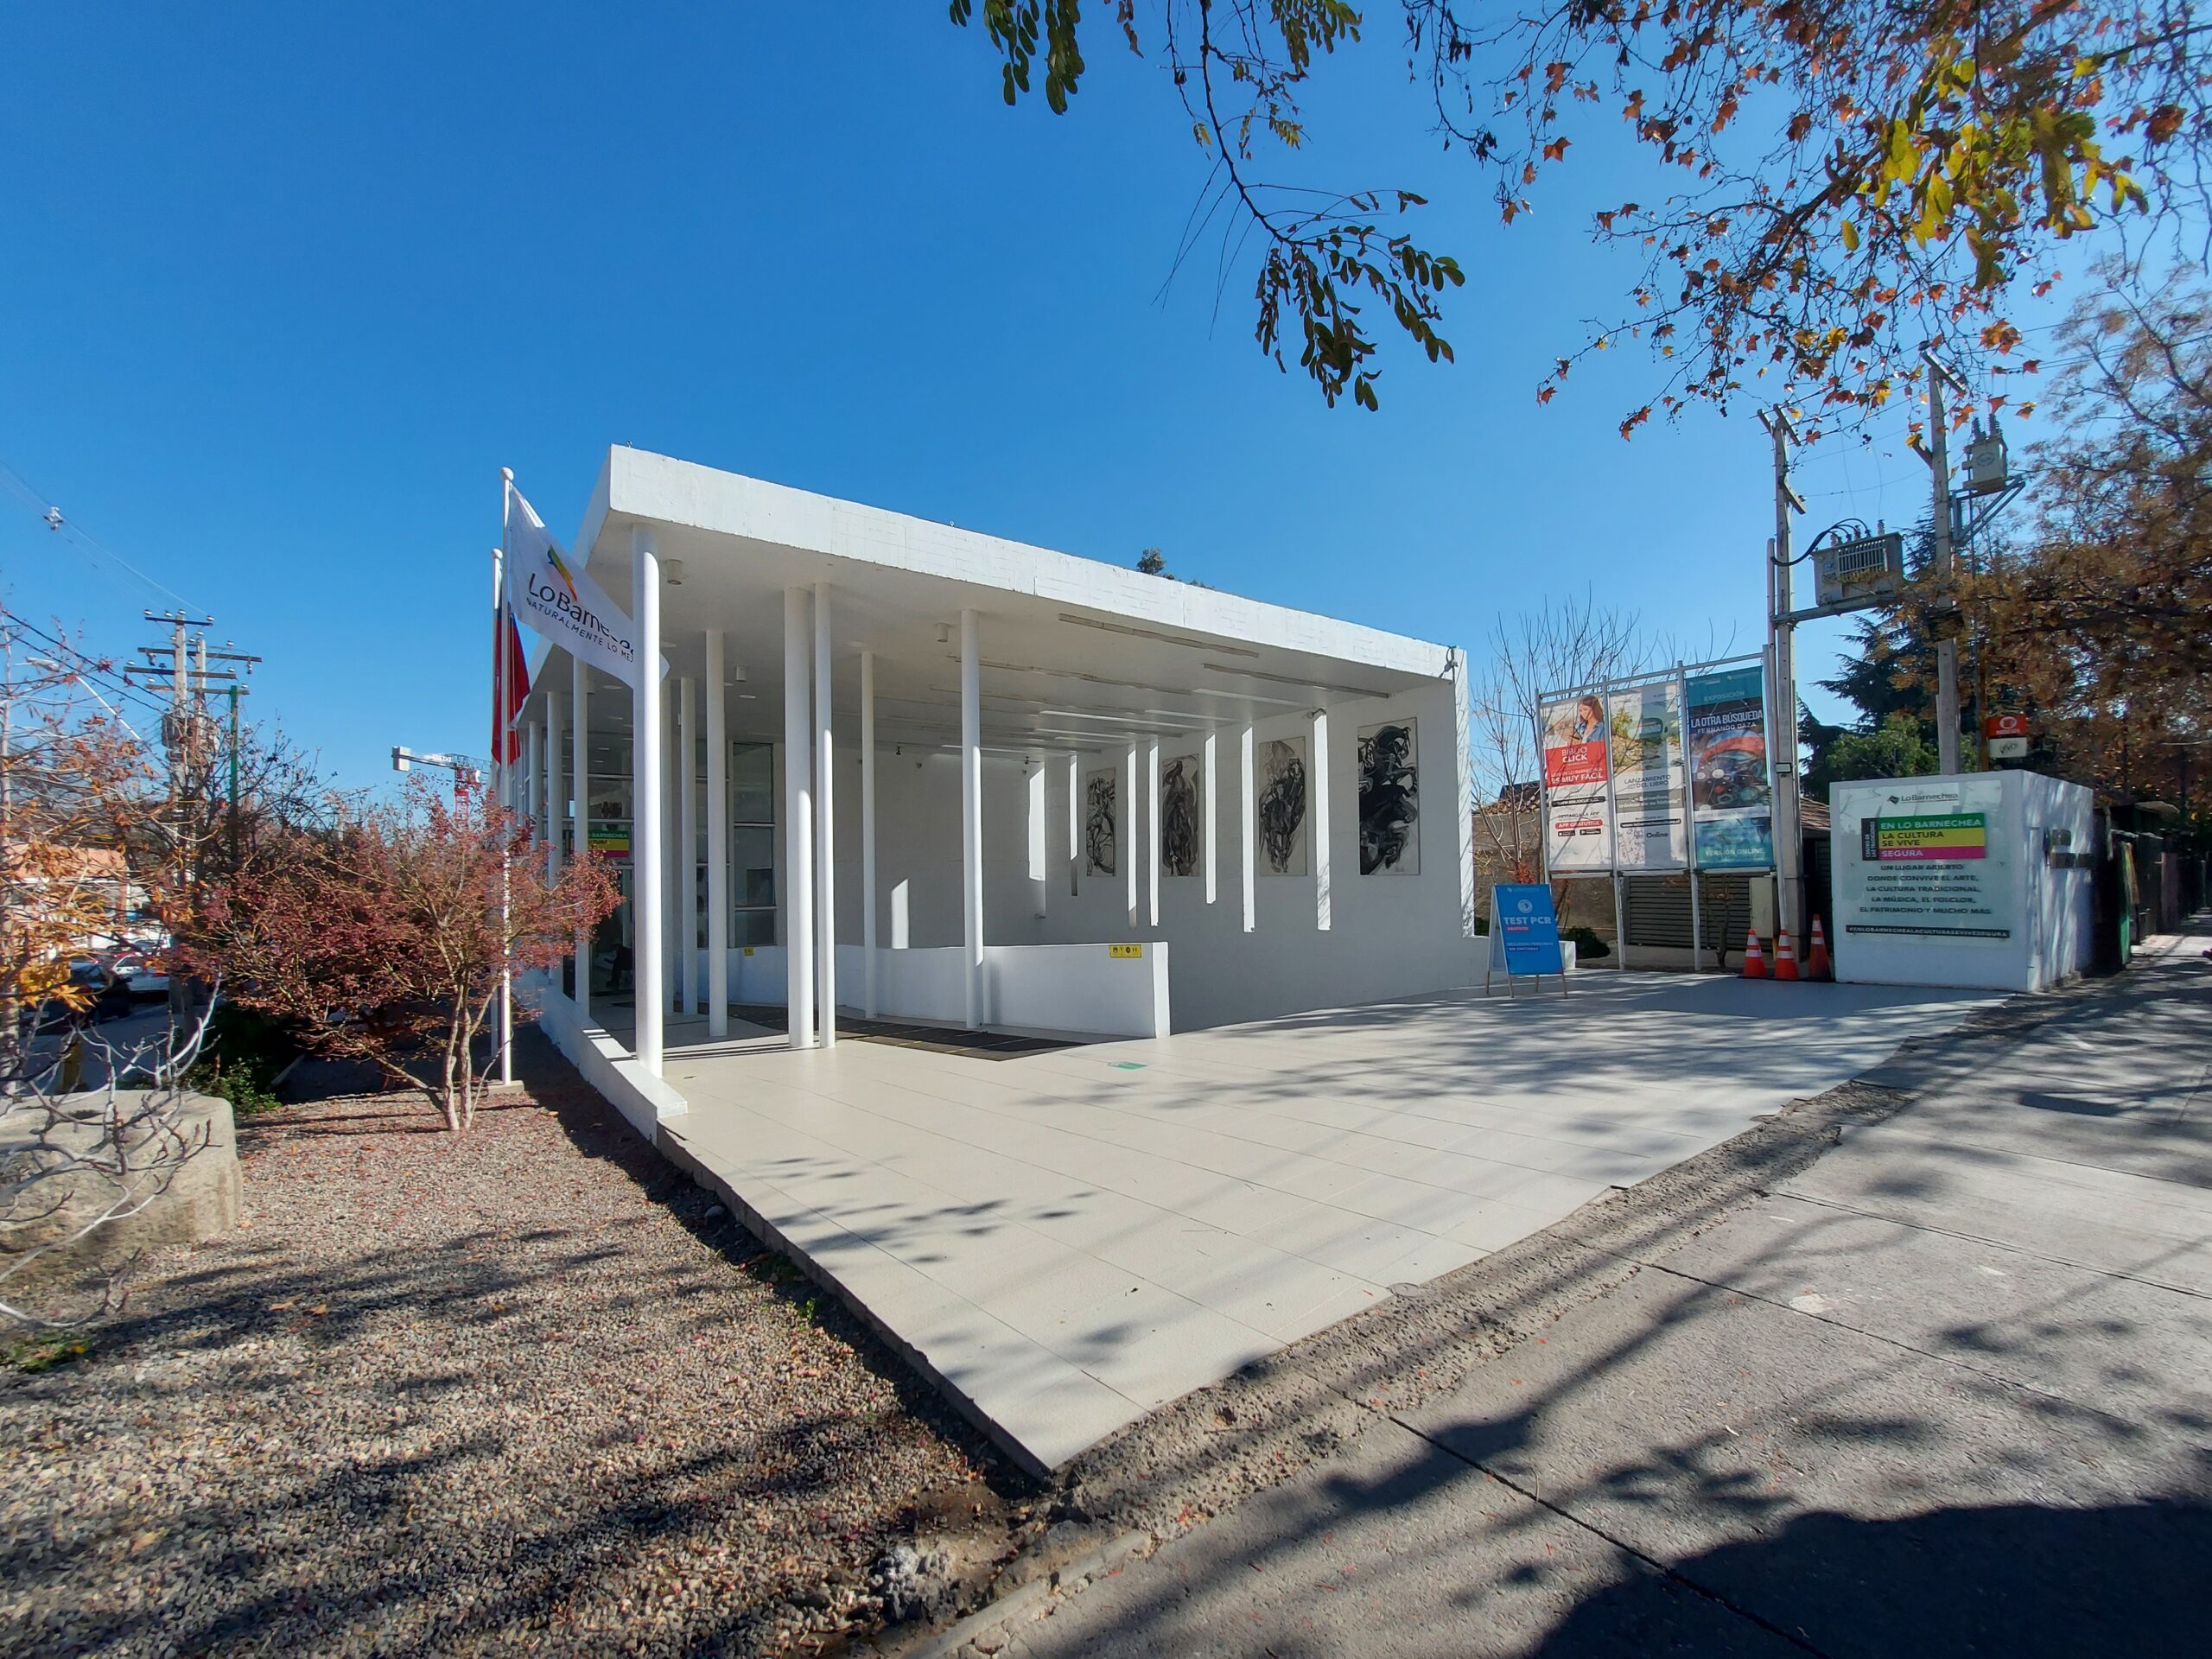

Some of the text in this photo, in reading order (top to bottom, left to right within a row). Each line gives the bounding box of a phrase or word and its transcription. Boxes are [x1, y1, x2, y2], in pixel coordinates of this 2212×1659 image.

[526, 597, 634, 663] NATURALMENTE LO MEJ
[1704, 690, 1745, 702] EXPOSICIÓN
[1690, 709, 1763, 728] LA OTRA BÚSQUEDA
[1697, 724, 1735, 734] FERNANDO
[1562, 753, 1588, 763] CLICK
[1624, 774, 1671, 784] LANZAMIENTO
[1914, 818, 1982, 829] BARNECHEA
[1897, 830, 1944, 839] CULTURA
[1881, 849, 1923, 858] SEGURA
[1503, 916, 1552, 925] TEST PCR
